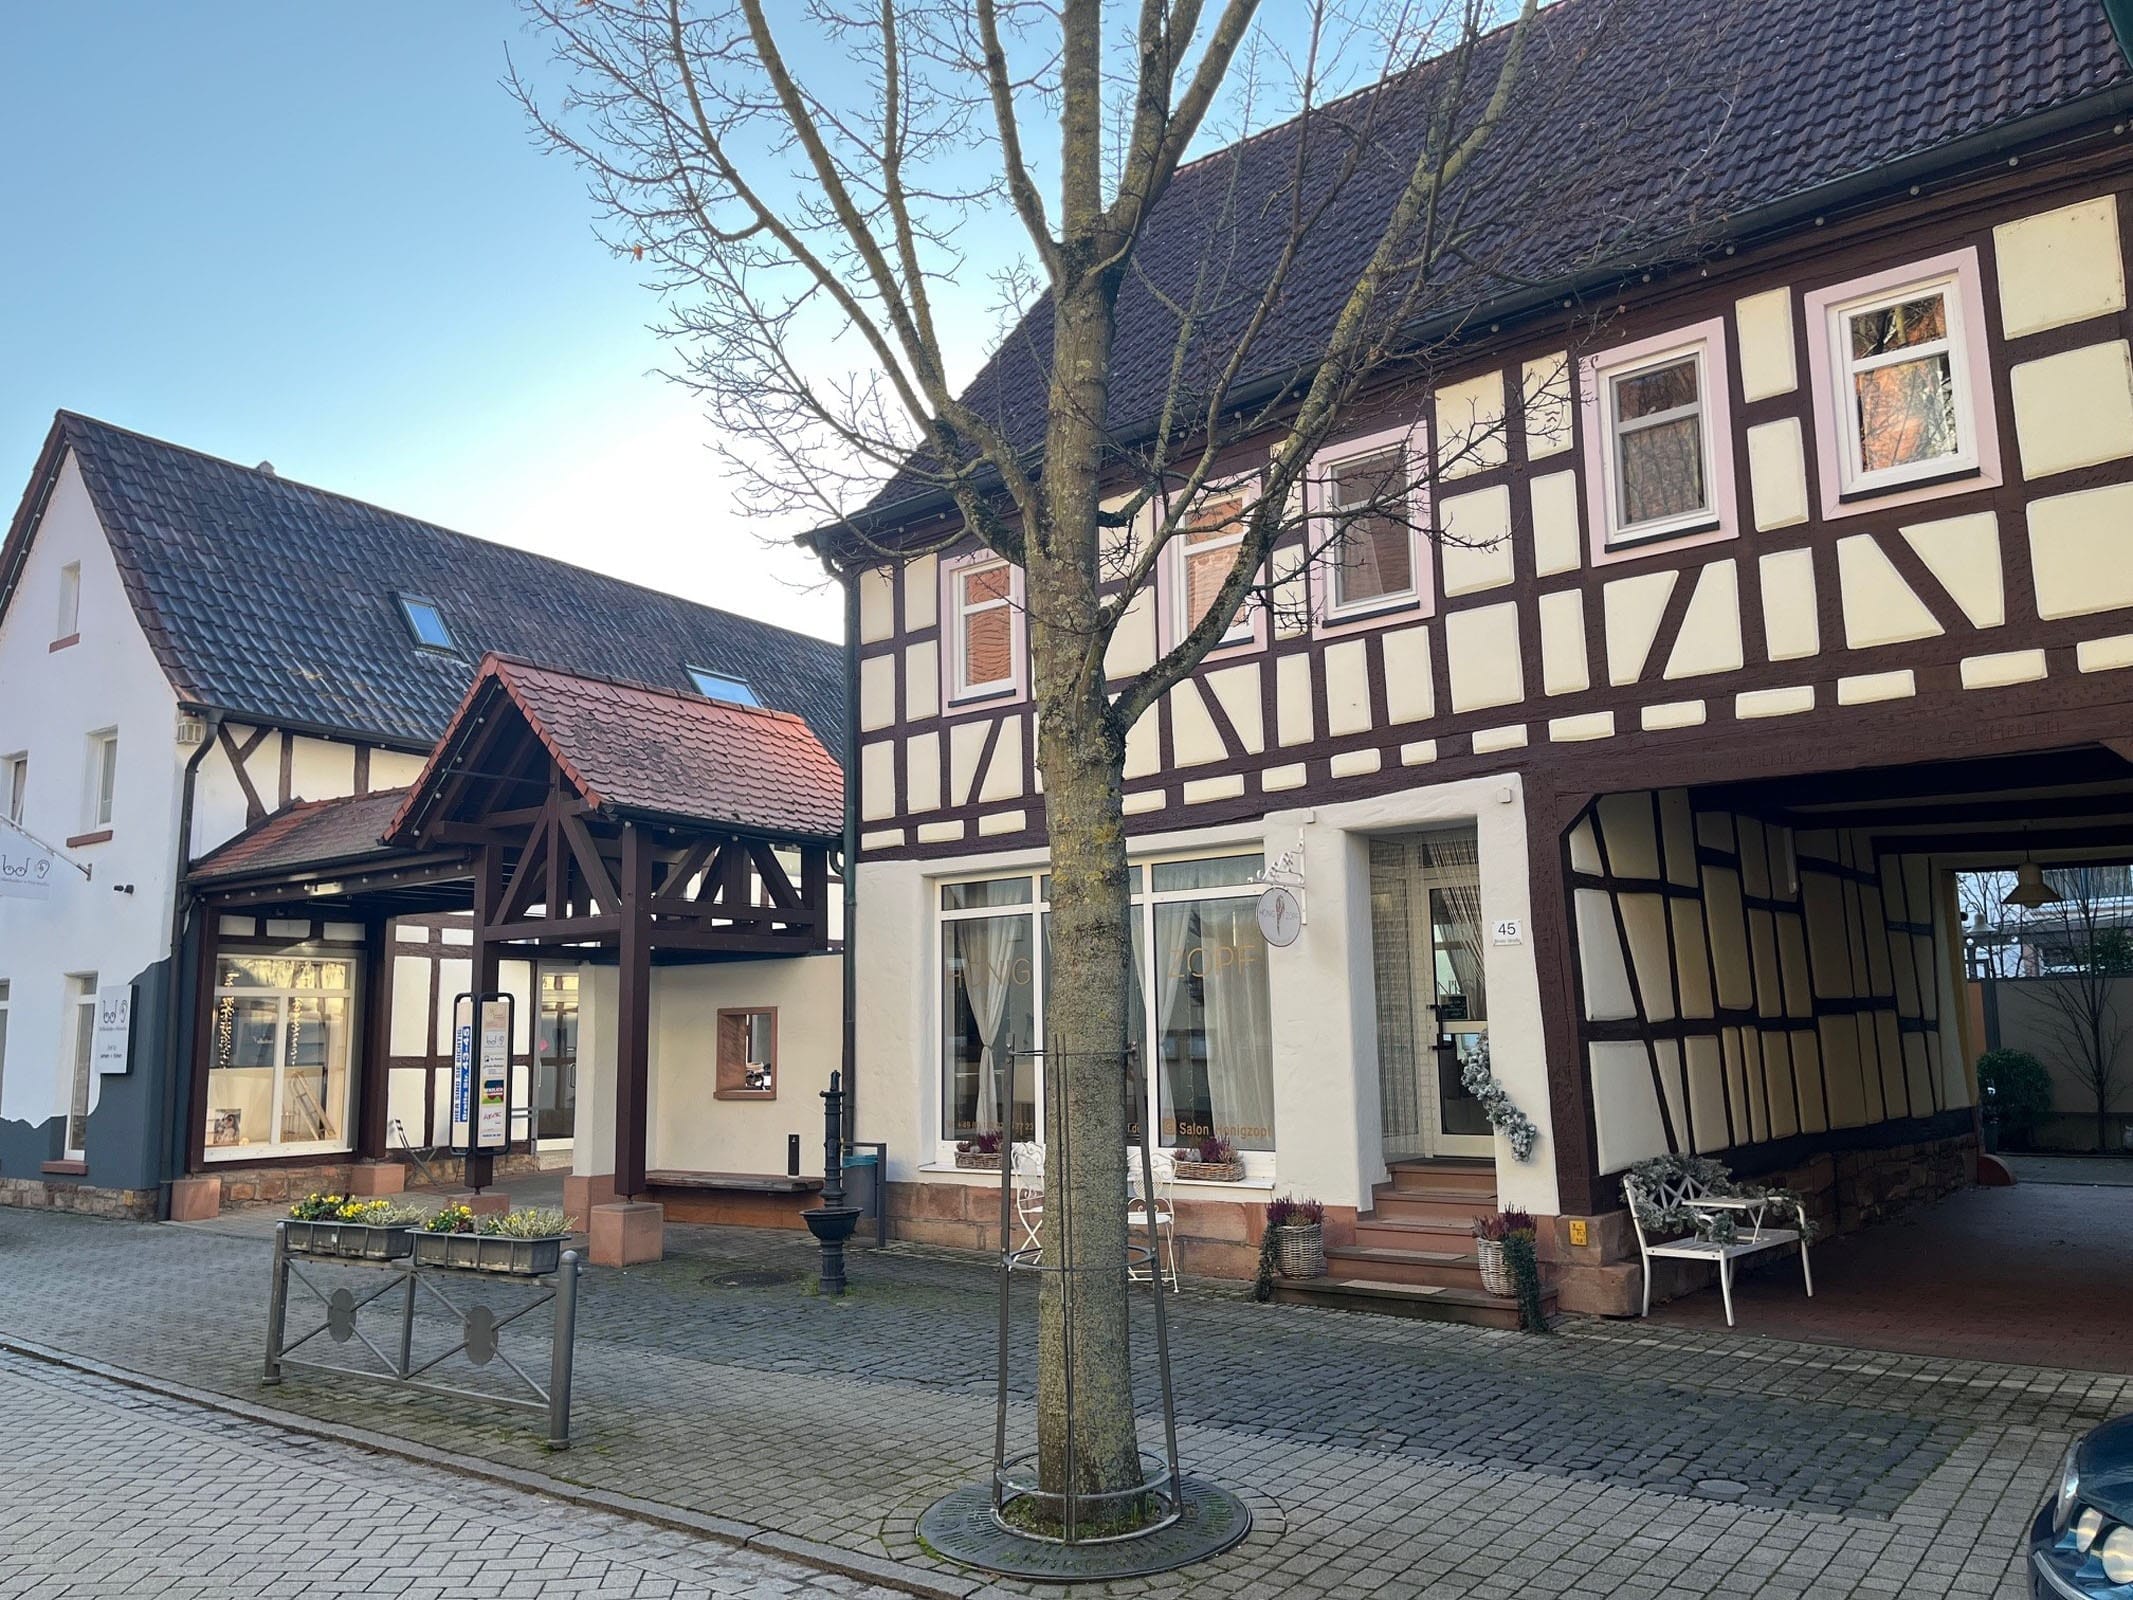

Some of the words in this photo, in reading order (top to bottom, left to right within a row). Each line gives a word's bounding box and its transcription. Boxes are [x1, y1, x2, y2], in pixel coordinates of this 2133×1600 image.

[1498, 922, 1516, 935] 45
[1168, 944, 1256, 978] ZOPF
[1179, 1122, 1209, 1135] Salon
